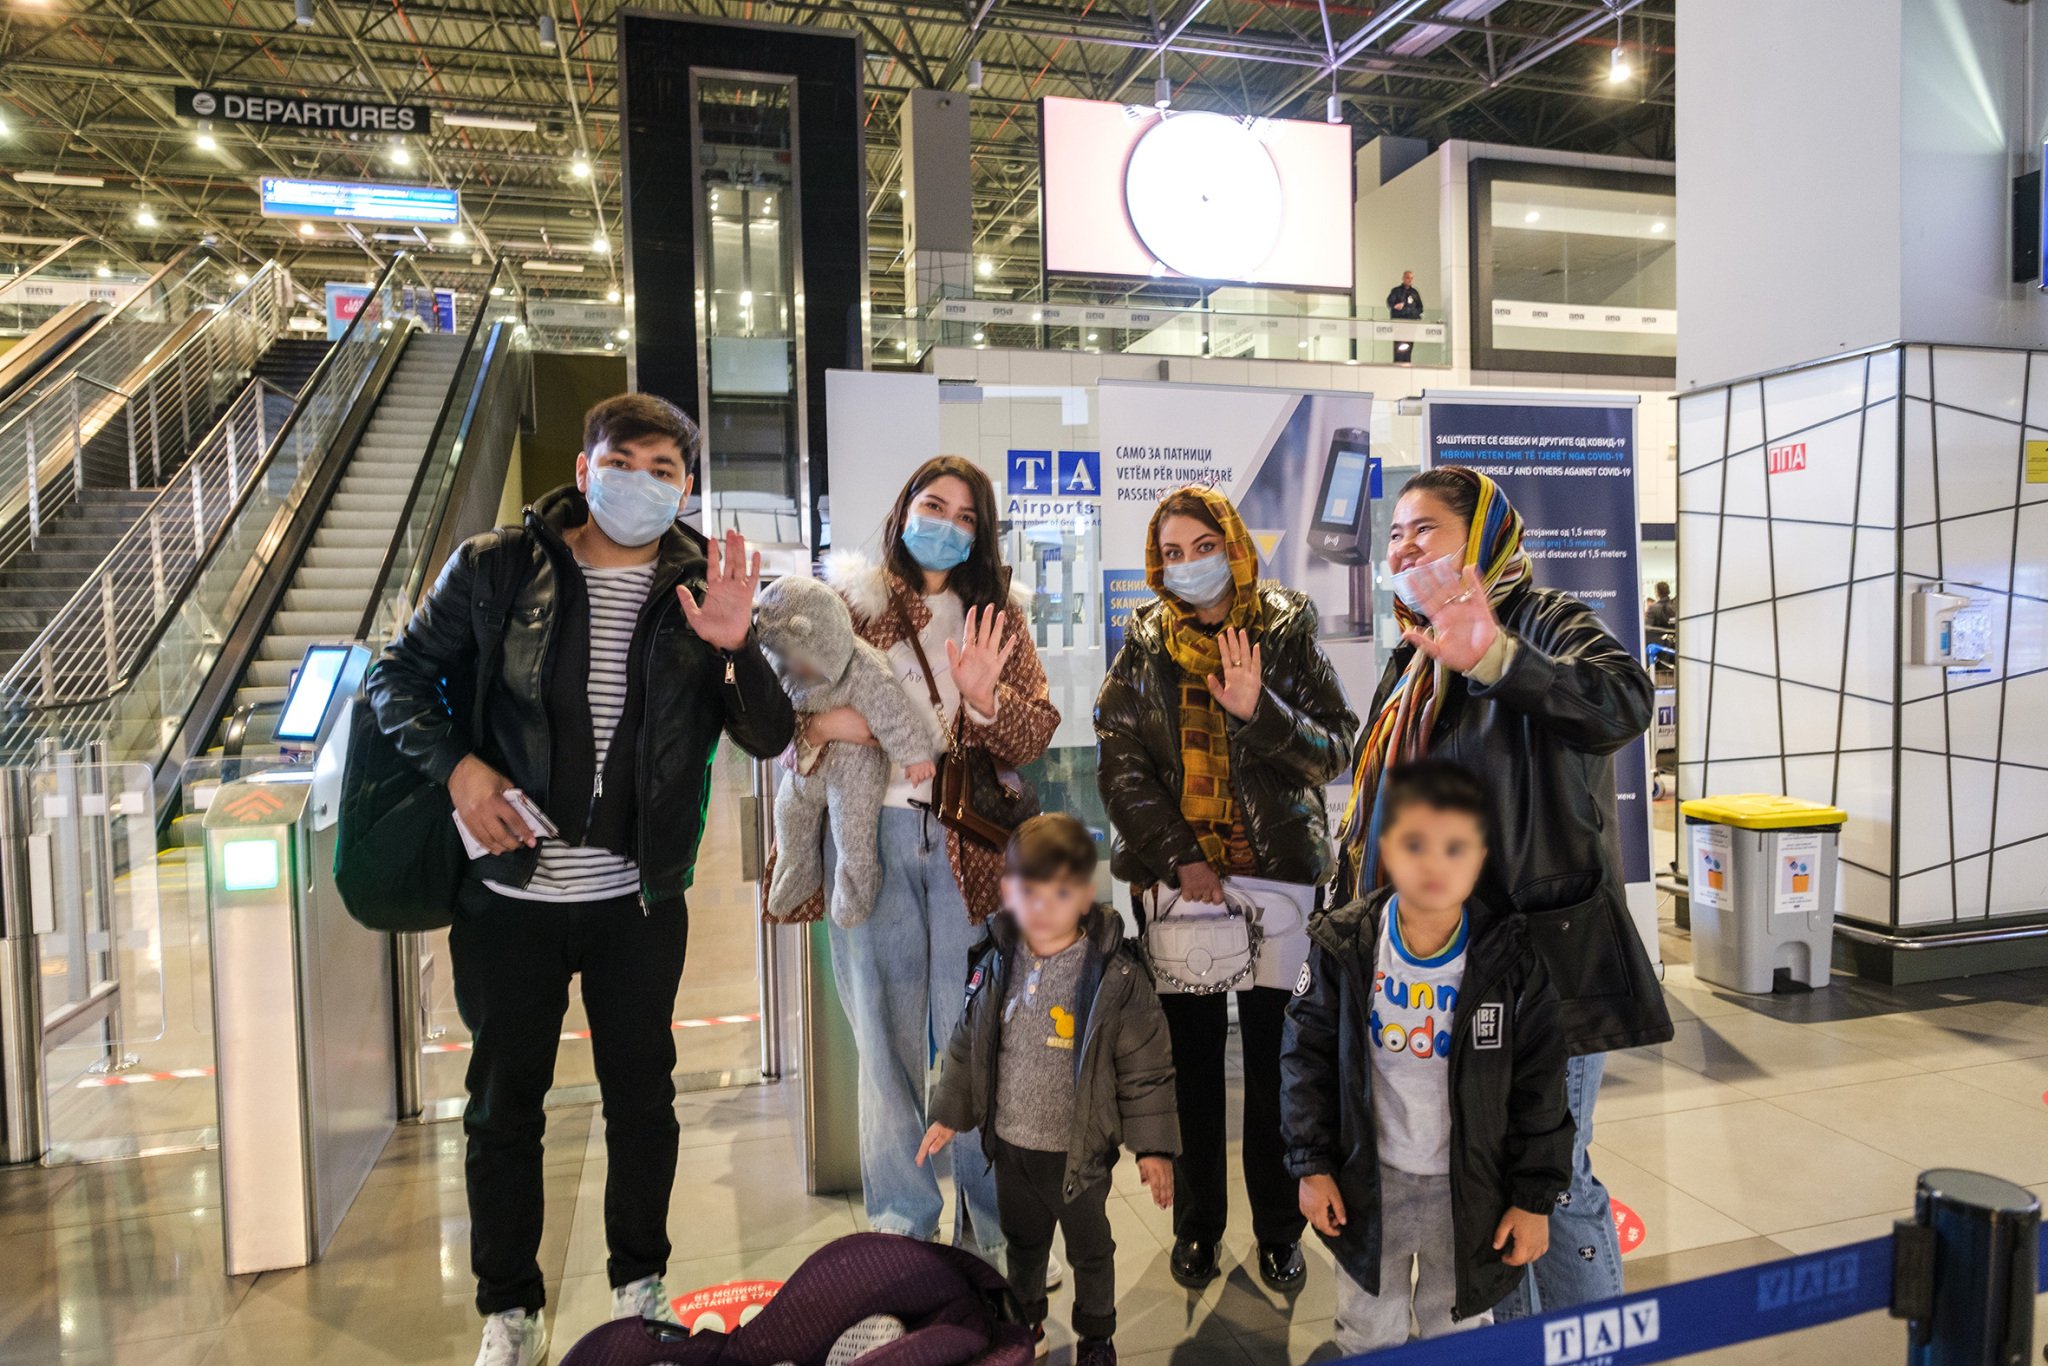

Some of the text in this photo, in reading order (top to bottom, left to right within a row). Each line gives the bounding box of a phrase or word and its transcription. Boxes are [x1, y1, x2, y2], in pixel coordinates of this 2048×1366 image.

[224, 95, 416, 131] DEPARTURES
[1436, 434, 1486, 445] ЗАШТИТЕТЕ
[1487, 435, 1498, 445] СЕ
[1499, 435, 1531, 446] СЕБЕСИ
[1539, 436, 1574, 447] ДРУГИТЕ
[1587, 437, 1626, 448] КОВИД-19
[1116, 446, 1212, 463] САМО ЗА ПАТНИЦИ
[1117, 464, 1151, 480] VETËM
[1154, 465, 1173, 480] PËR
[1514, 466, 1532, 476] AND
[1533, 466, 1563, 477] OTHERS
[1564, 466, 1598, 477] AGAINST
[1598, 467, 1631, 477] COVID-19
[1117, 487, 1156, 501] PASSEN
[1007, 499, 1096, 518] Airports
[1547, 1304, 1656, 1361] TAV
